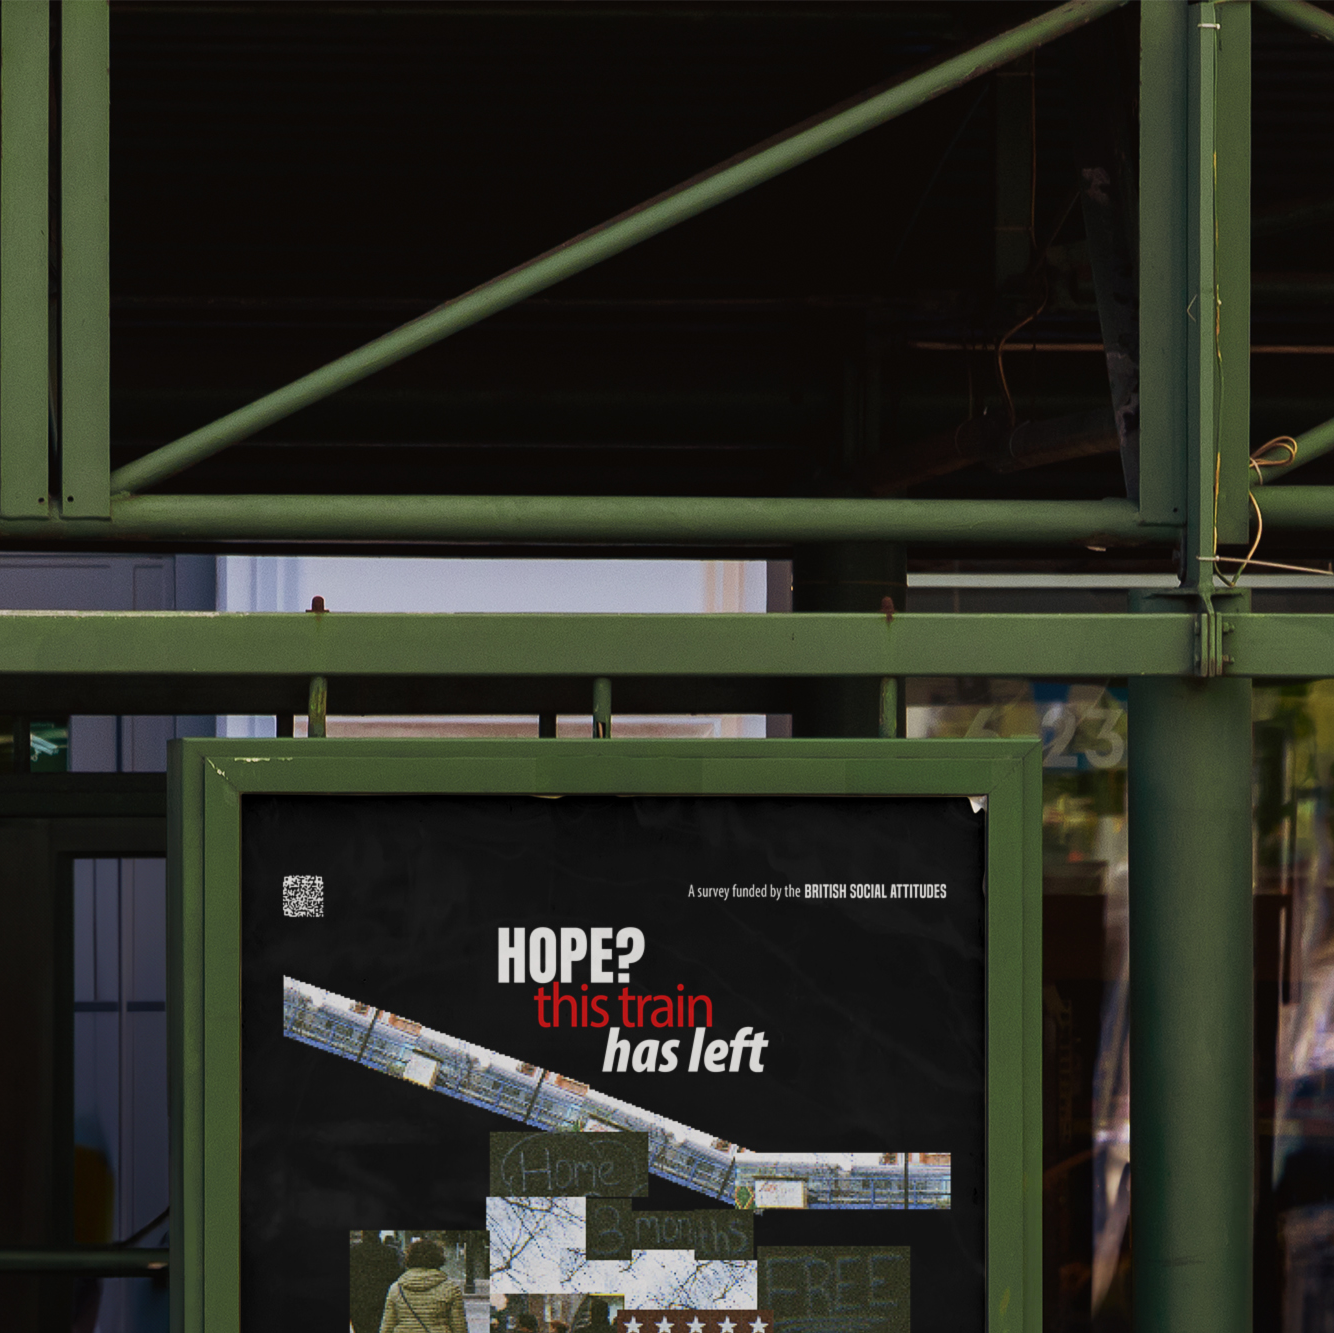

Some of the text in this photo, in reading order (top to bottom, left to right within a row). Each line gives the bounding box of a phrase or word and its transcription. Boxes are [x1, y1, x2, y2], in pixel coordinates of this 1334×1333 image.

[1040, 701, 1125, 769] 23
[687, 883, 947, 901] A survey funded by the BRITISH SOCIAL ATTITUDES
[497, 926, 646, 984] HOPE?
[533, 981, 713, 1029] this train
[601, 1026, 770, 1073] has left
[519, 1147, 621, 1193] Home
[766, 1254, 904, 1318] FREE
